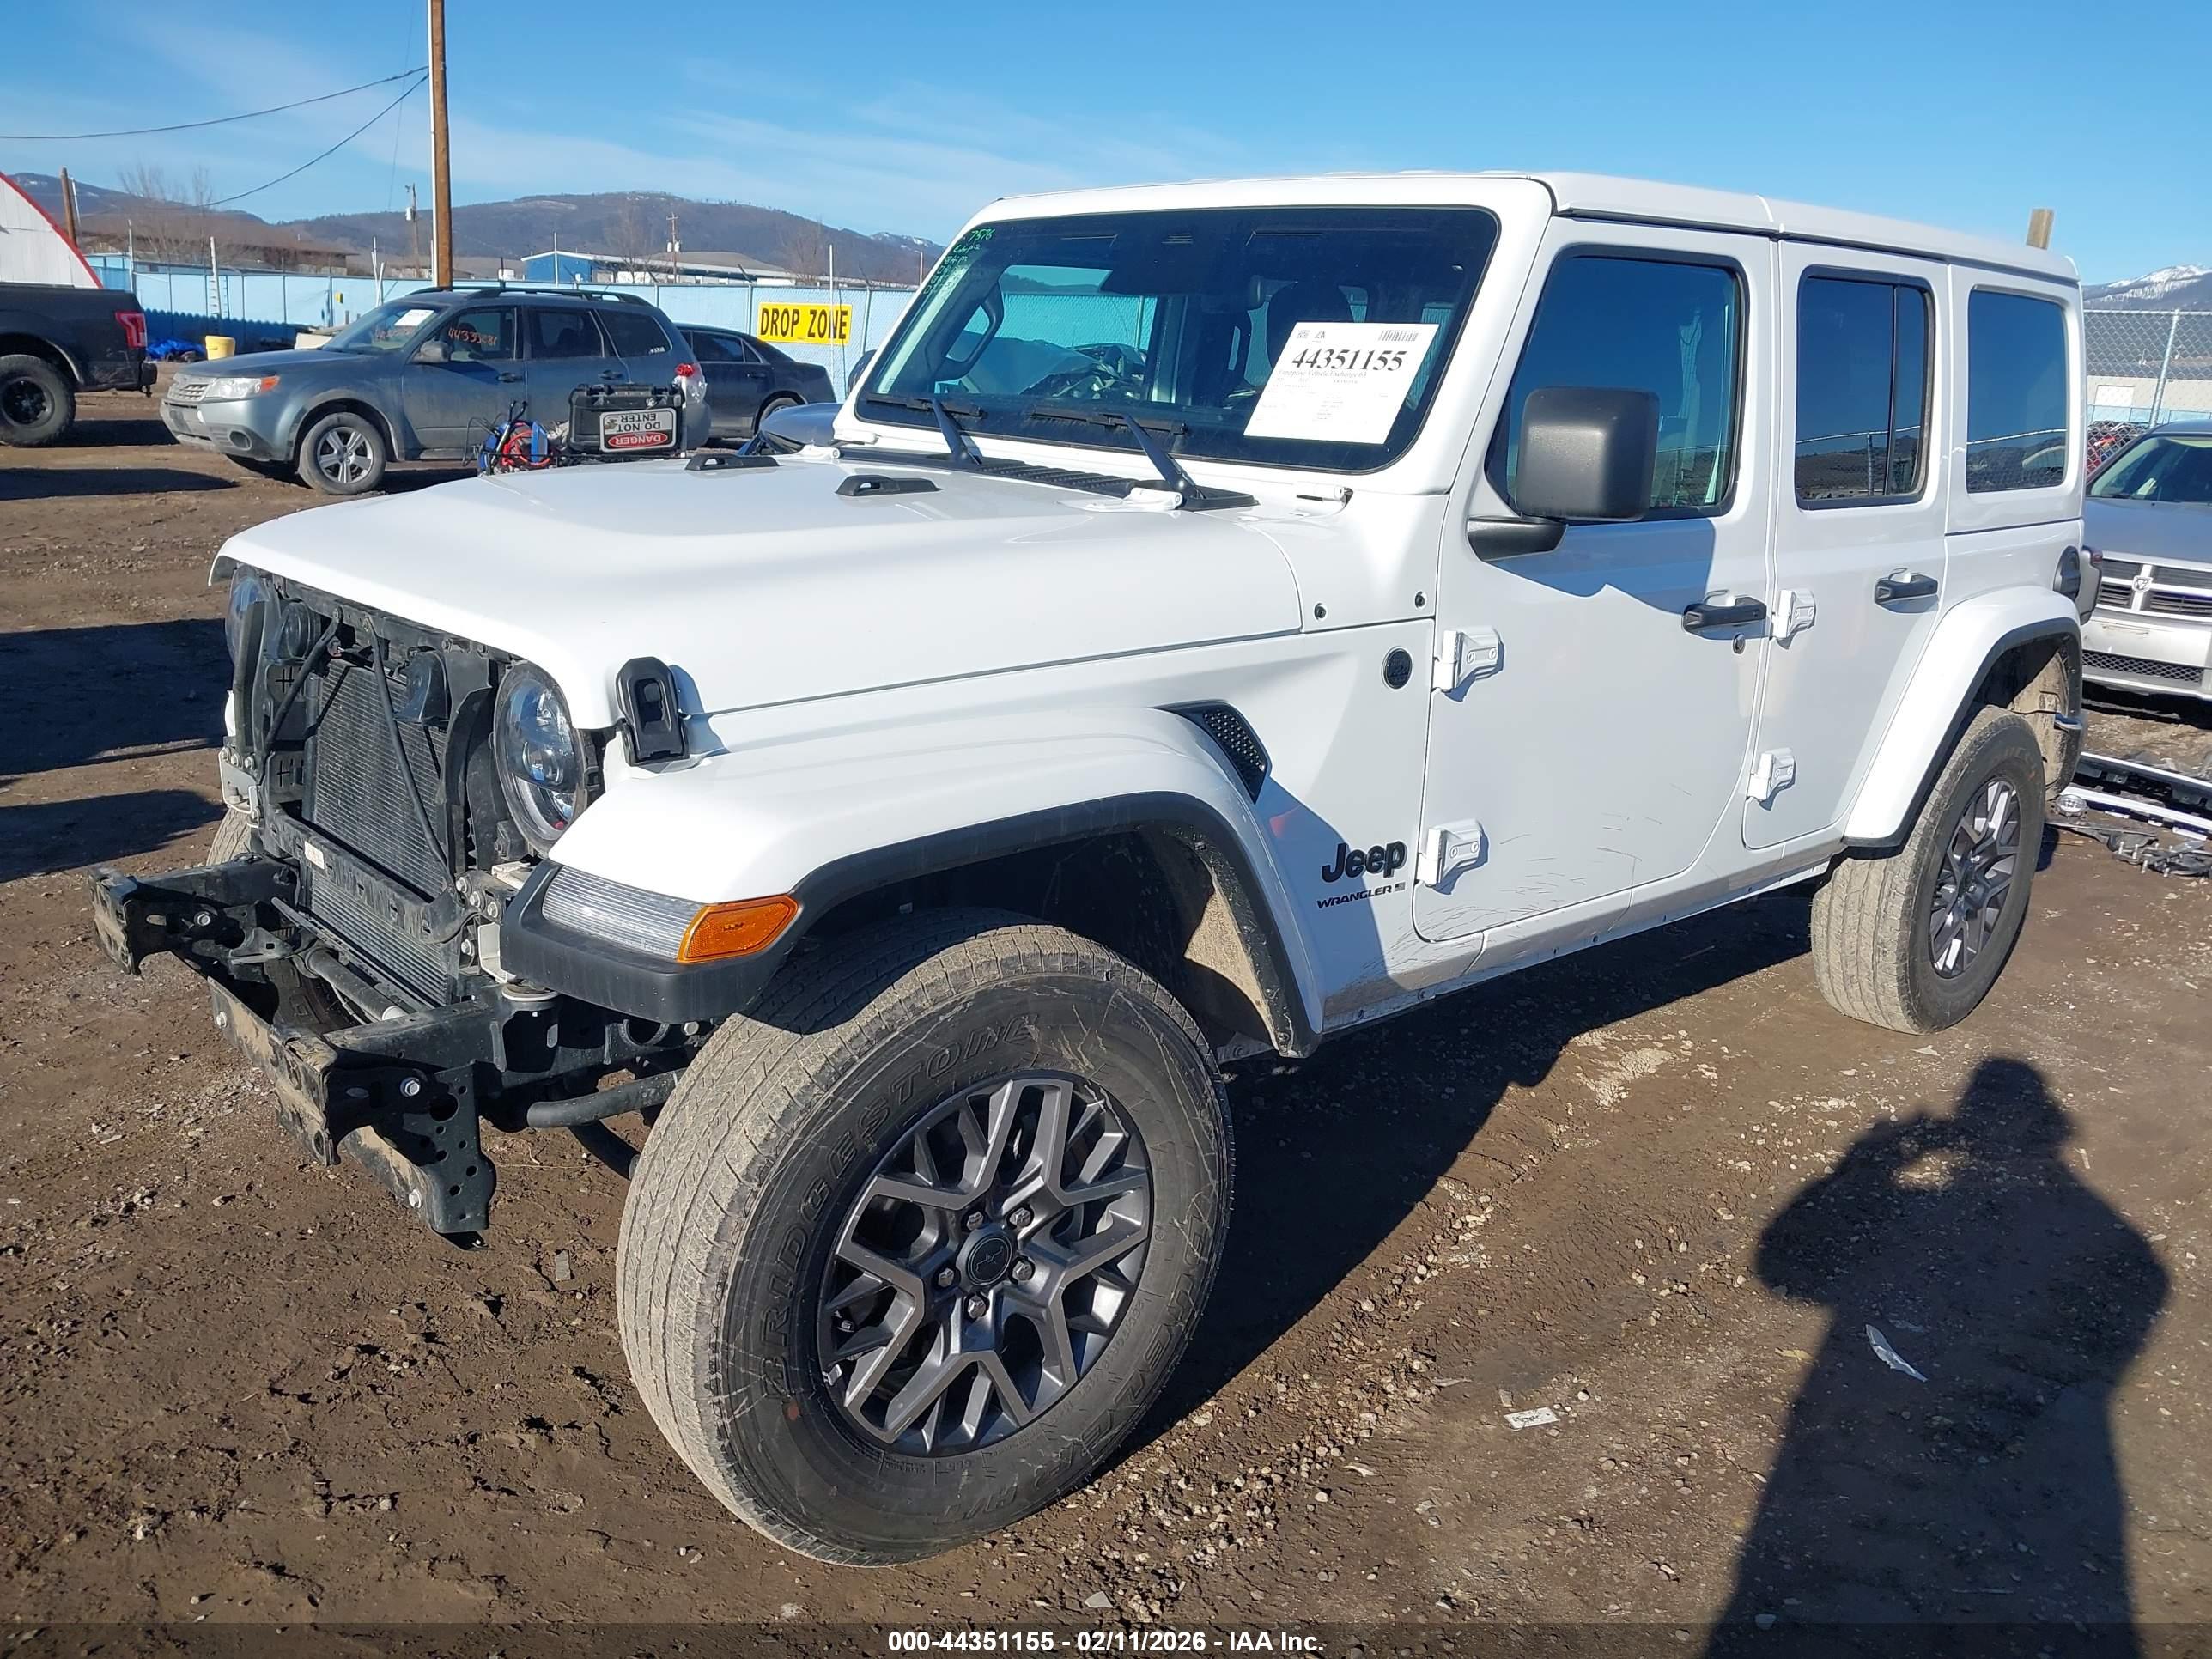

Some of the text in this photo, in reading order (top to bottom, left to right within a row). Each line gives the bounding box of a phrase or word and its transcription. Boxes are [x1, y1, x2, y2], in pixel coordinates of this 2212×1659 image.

[760, 307, 848, 340] DROP ZONE
[1291, 349, 1407, 371] 44351155
[618, 422, 660, 432] DO NOT
[622, 413, 656, 422] ENTER
[616, 434, 661, 445] DANGER
[1322, 841, 1407, 883] Jeep
[1316, 885, 1392, 908] WRANGLER
[759, 1014, 1041, 1398] BRIDGESTONE
